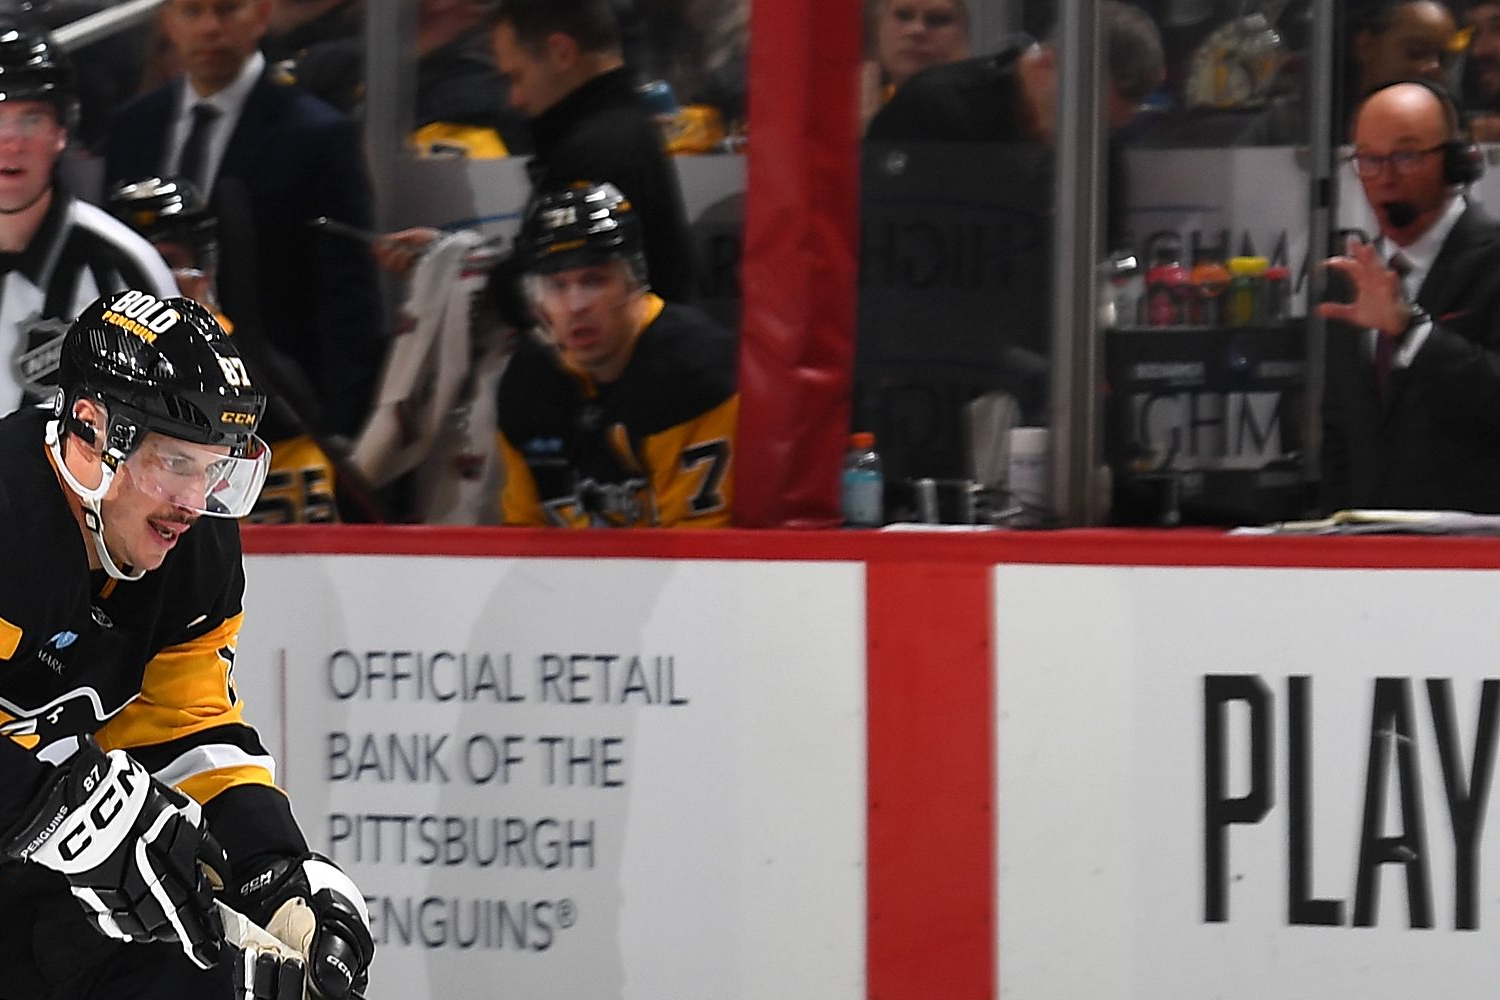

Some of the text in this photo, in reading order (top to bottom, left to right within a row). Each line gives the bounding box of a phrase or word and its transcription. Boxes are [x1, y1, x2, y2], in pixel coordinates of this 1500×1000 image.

[102, 310, 158, 344] PENGUIN
[111, 289, 178, 335] BOLD
[219, 356, 251, 388] 87
[220, 411, 257, 427] CCM
[328, 651, 689, 706] OFFICIAL RETAIL
[83, 764, 101, 793] 87
[328, 732, 625, 788] BANK OF THE
[57, 755, 144, 862] CCM
[1204, 673, 1500, 931] PLAY
[20, 804, 69, 864] PENGUINS
[329, 813, 596, 869] PITTSBURGH
